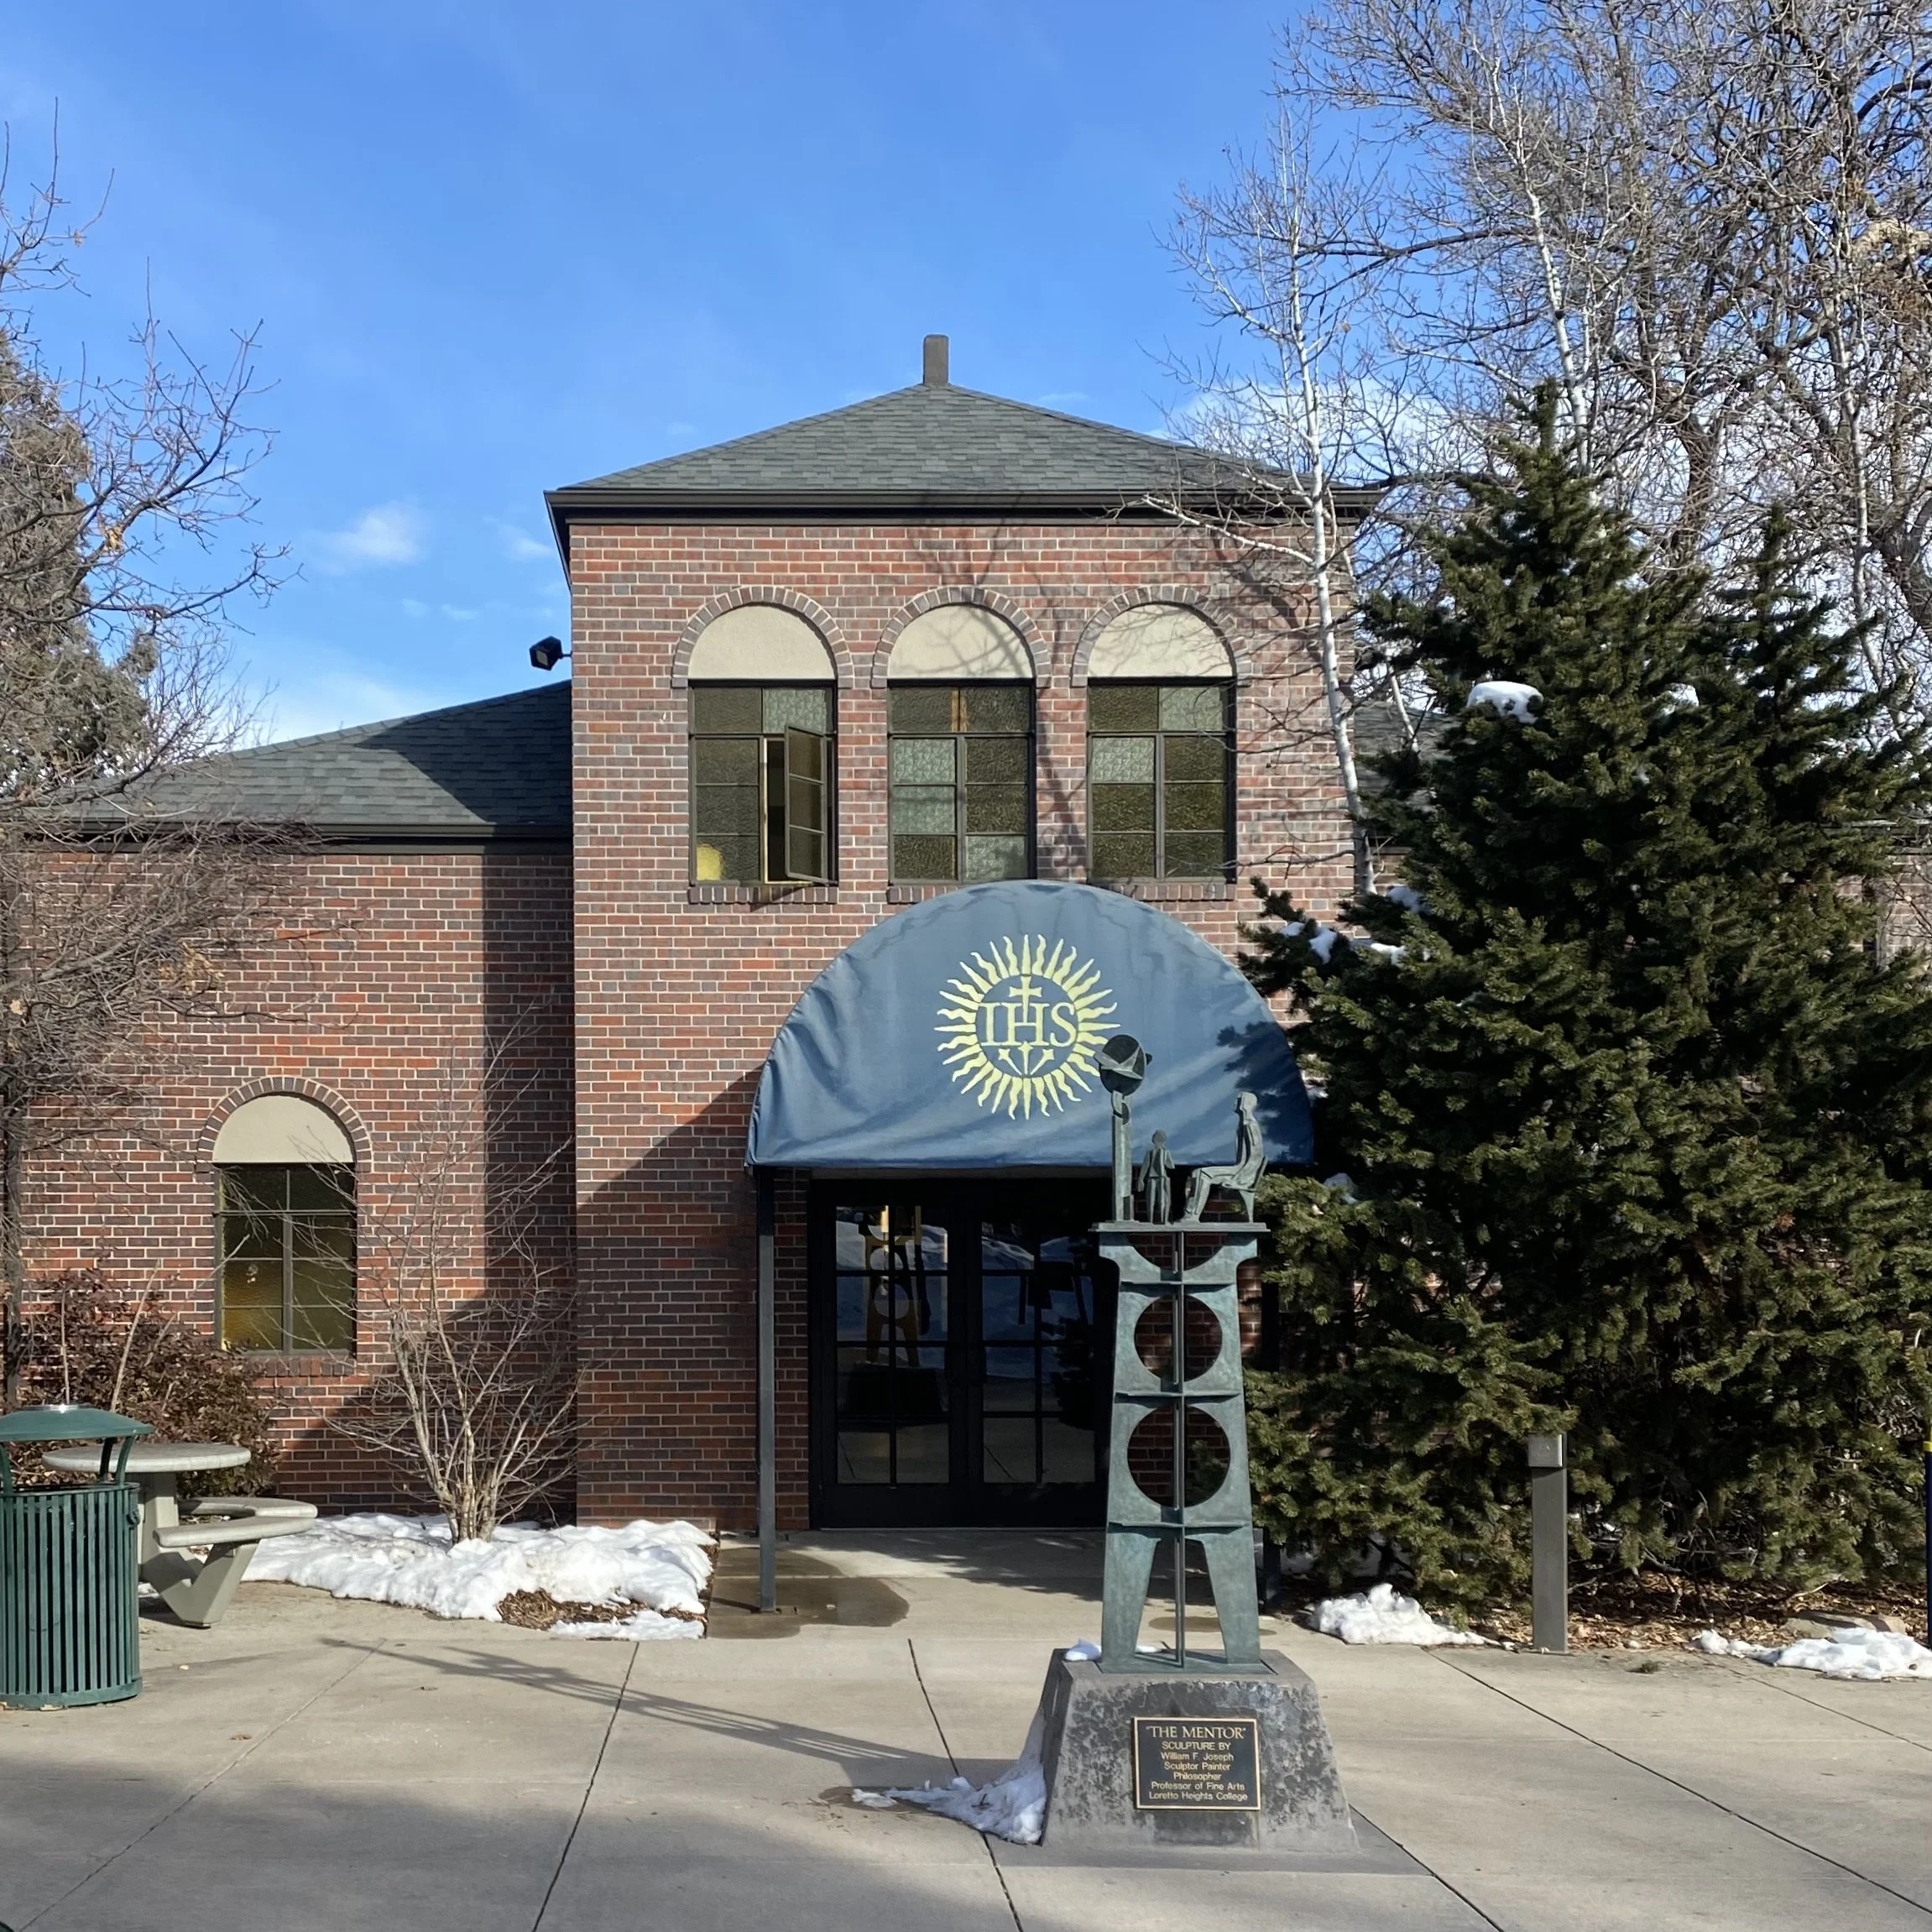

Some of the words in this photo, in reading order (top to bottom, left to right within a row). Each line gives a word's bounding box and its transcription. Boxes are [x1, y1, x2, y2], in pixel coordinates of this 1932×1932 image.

[979, 1002, 1078, 1047] IHS
[1162, 1741, 1215, 1750] SCULPTURE
[1219, 1742, 1231, 1751] BY
[1203, 1753, 1234, 1762] Joseph
[1164, 1762, 1198, 1772] Sculptor
[1202, 1762, 1230, 1771] Painter
[1173, 1772, 1222, 1781] Philosopher
[1151, 1781, 1191, 1790] Professor
[1182, 1792, 1213, 1801] Heights
[1216, 1792, 1248, 1802] College
